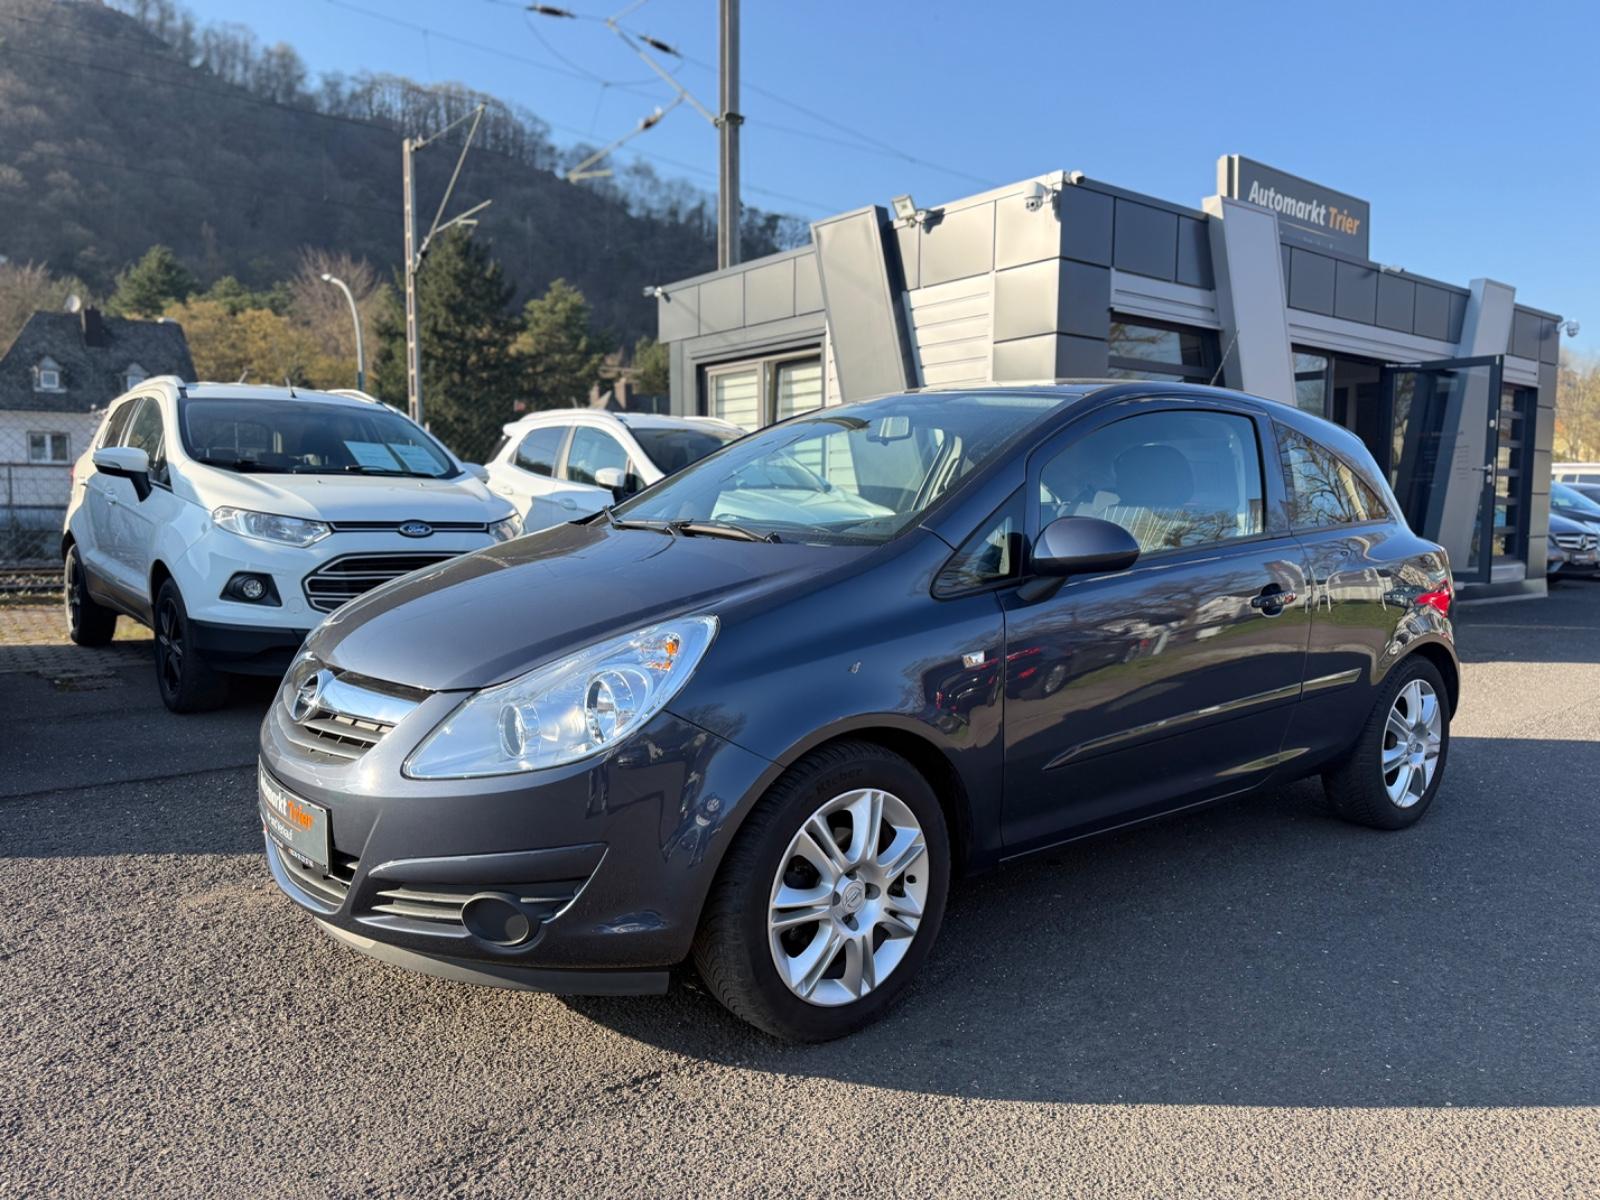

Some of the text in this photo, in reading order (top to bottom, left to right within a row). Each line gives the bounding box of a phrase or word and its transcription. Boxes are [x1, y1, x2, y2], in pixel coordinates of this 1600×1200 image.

[1249, 180, 1361, 235] Automarkt Trier
[288, 800, 314, 832] Trier
